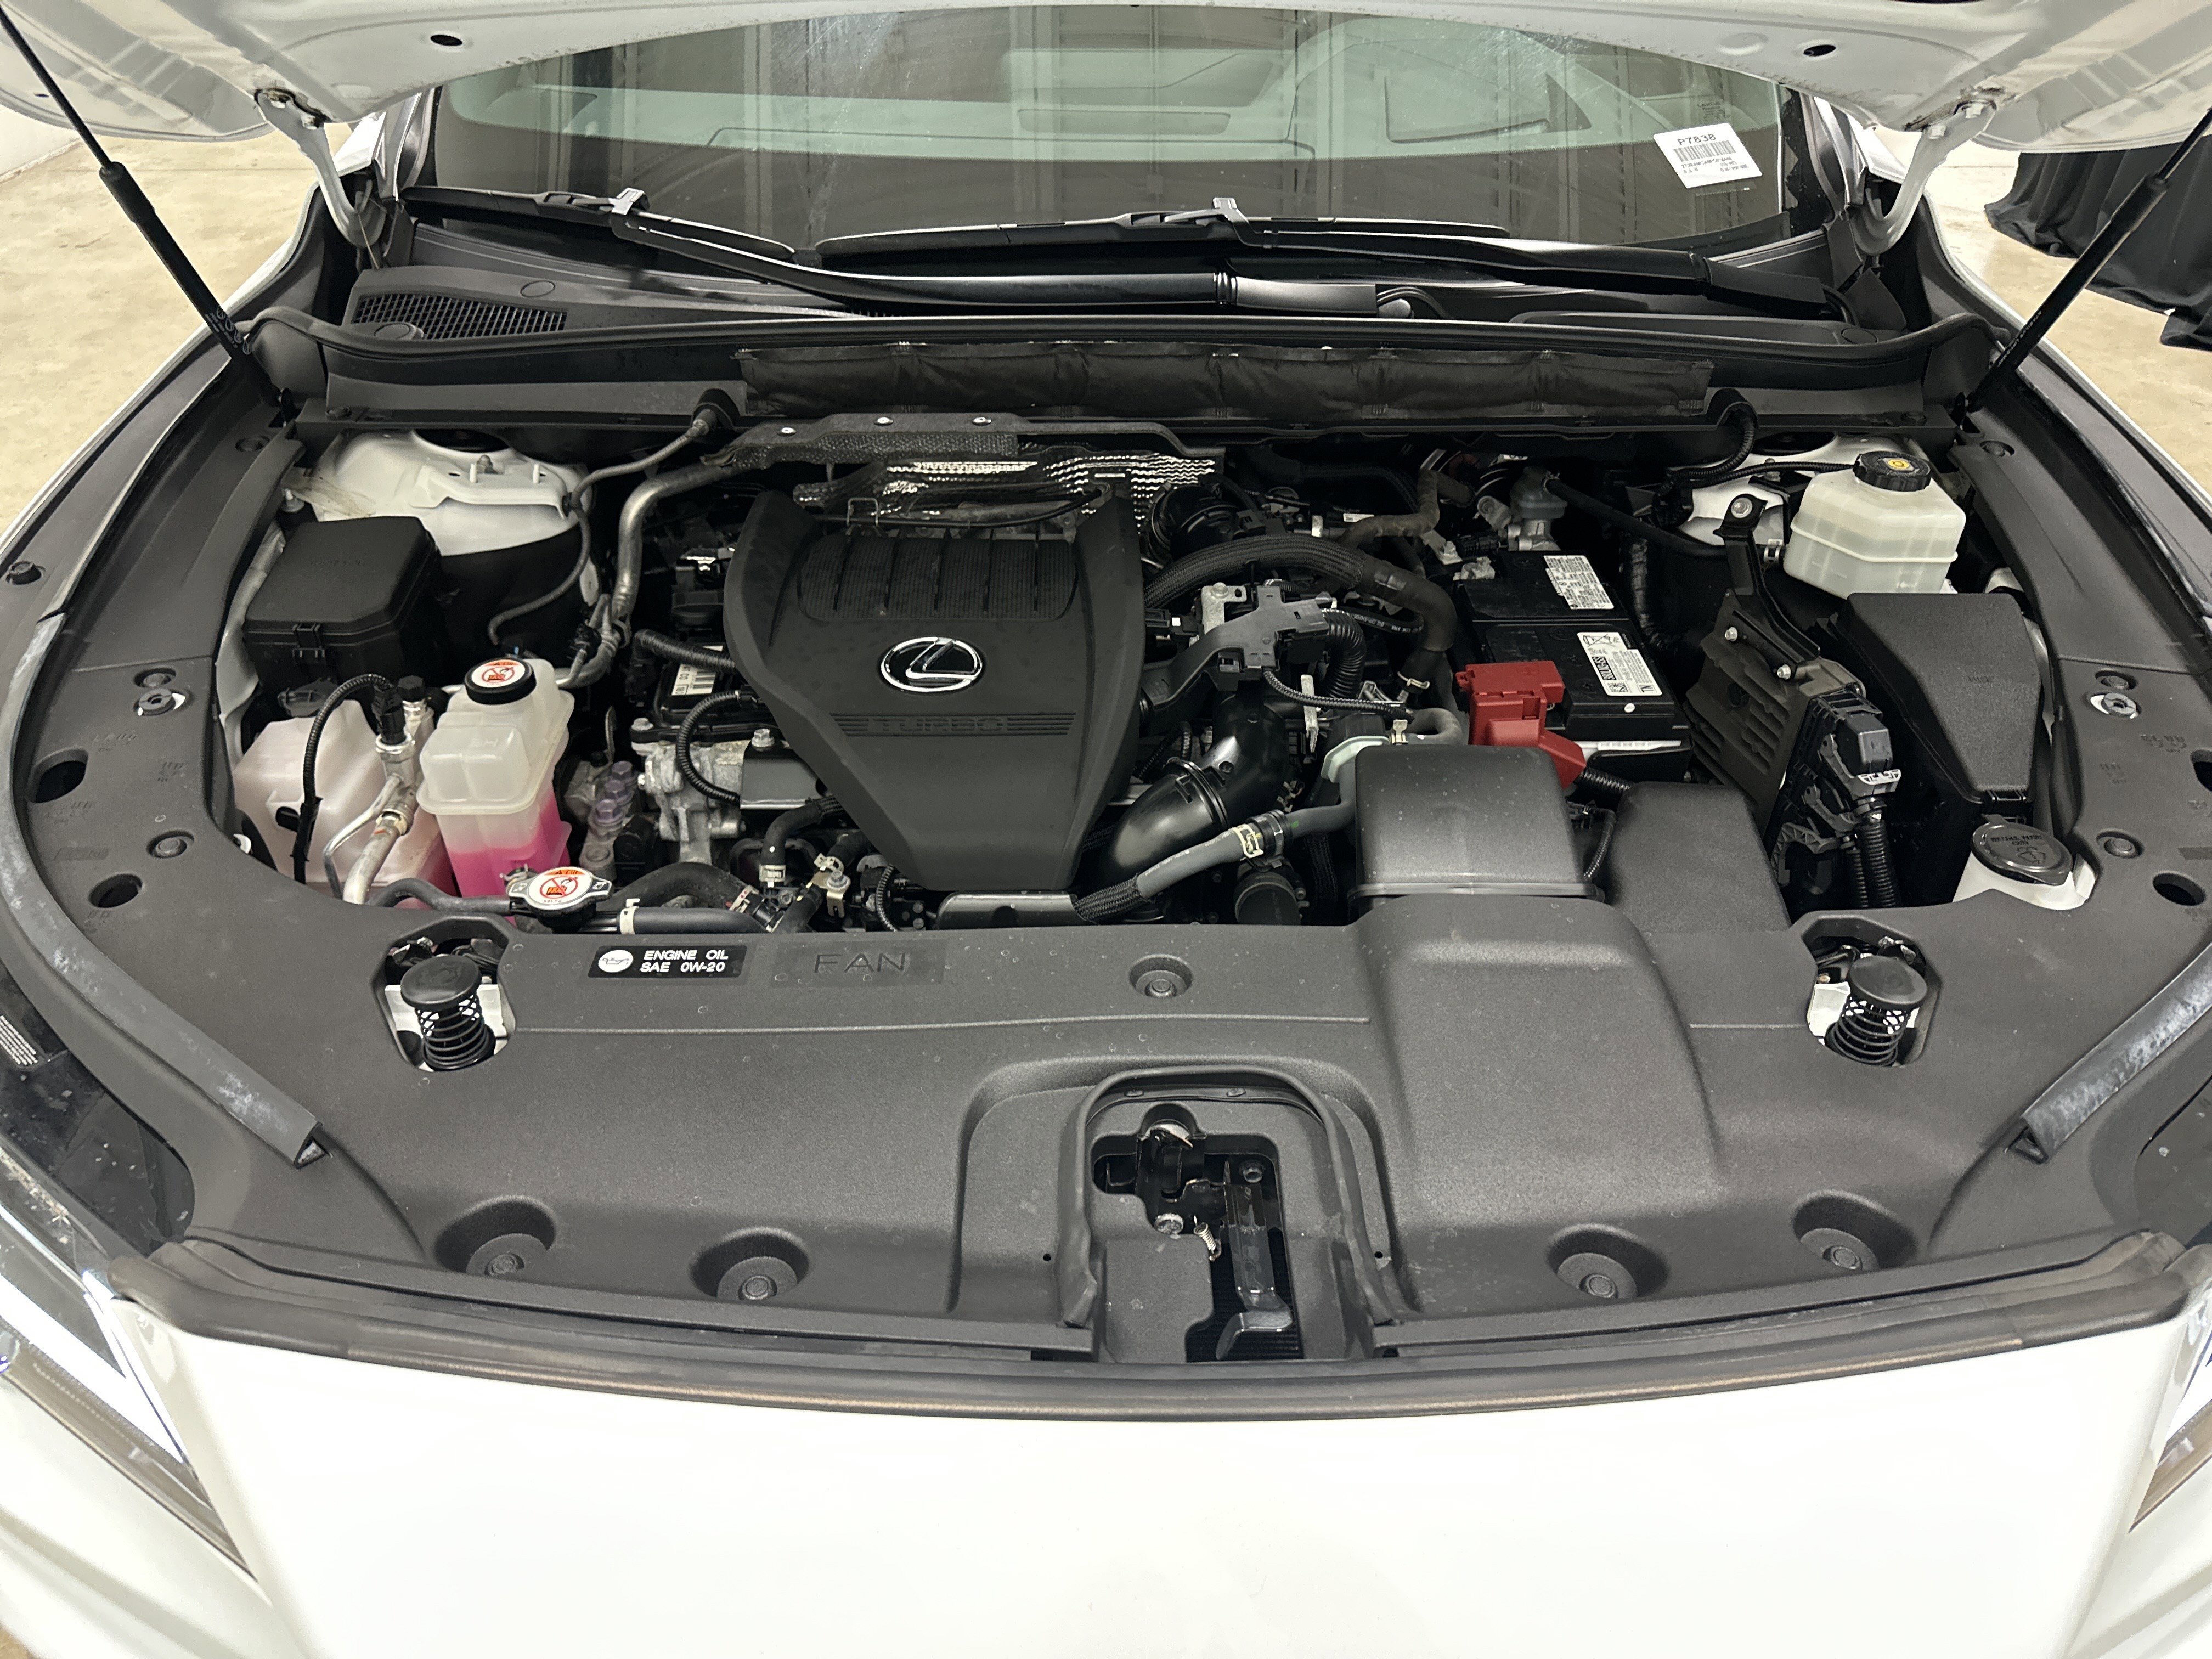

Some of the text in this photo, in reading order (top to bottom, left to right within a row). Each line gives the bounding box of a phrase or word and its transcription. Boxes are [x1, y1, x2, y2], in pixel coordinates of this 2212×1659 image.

[1677, 133, 1717, 146] P7838
[872, 717, 1003, 732] TURBO
[644, 950, 729, 960] ENGINE OIL
[640, 962, 726, 972] SAE 0W-20
[814, 952, 906, 973] FAN
